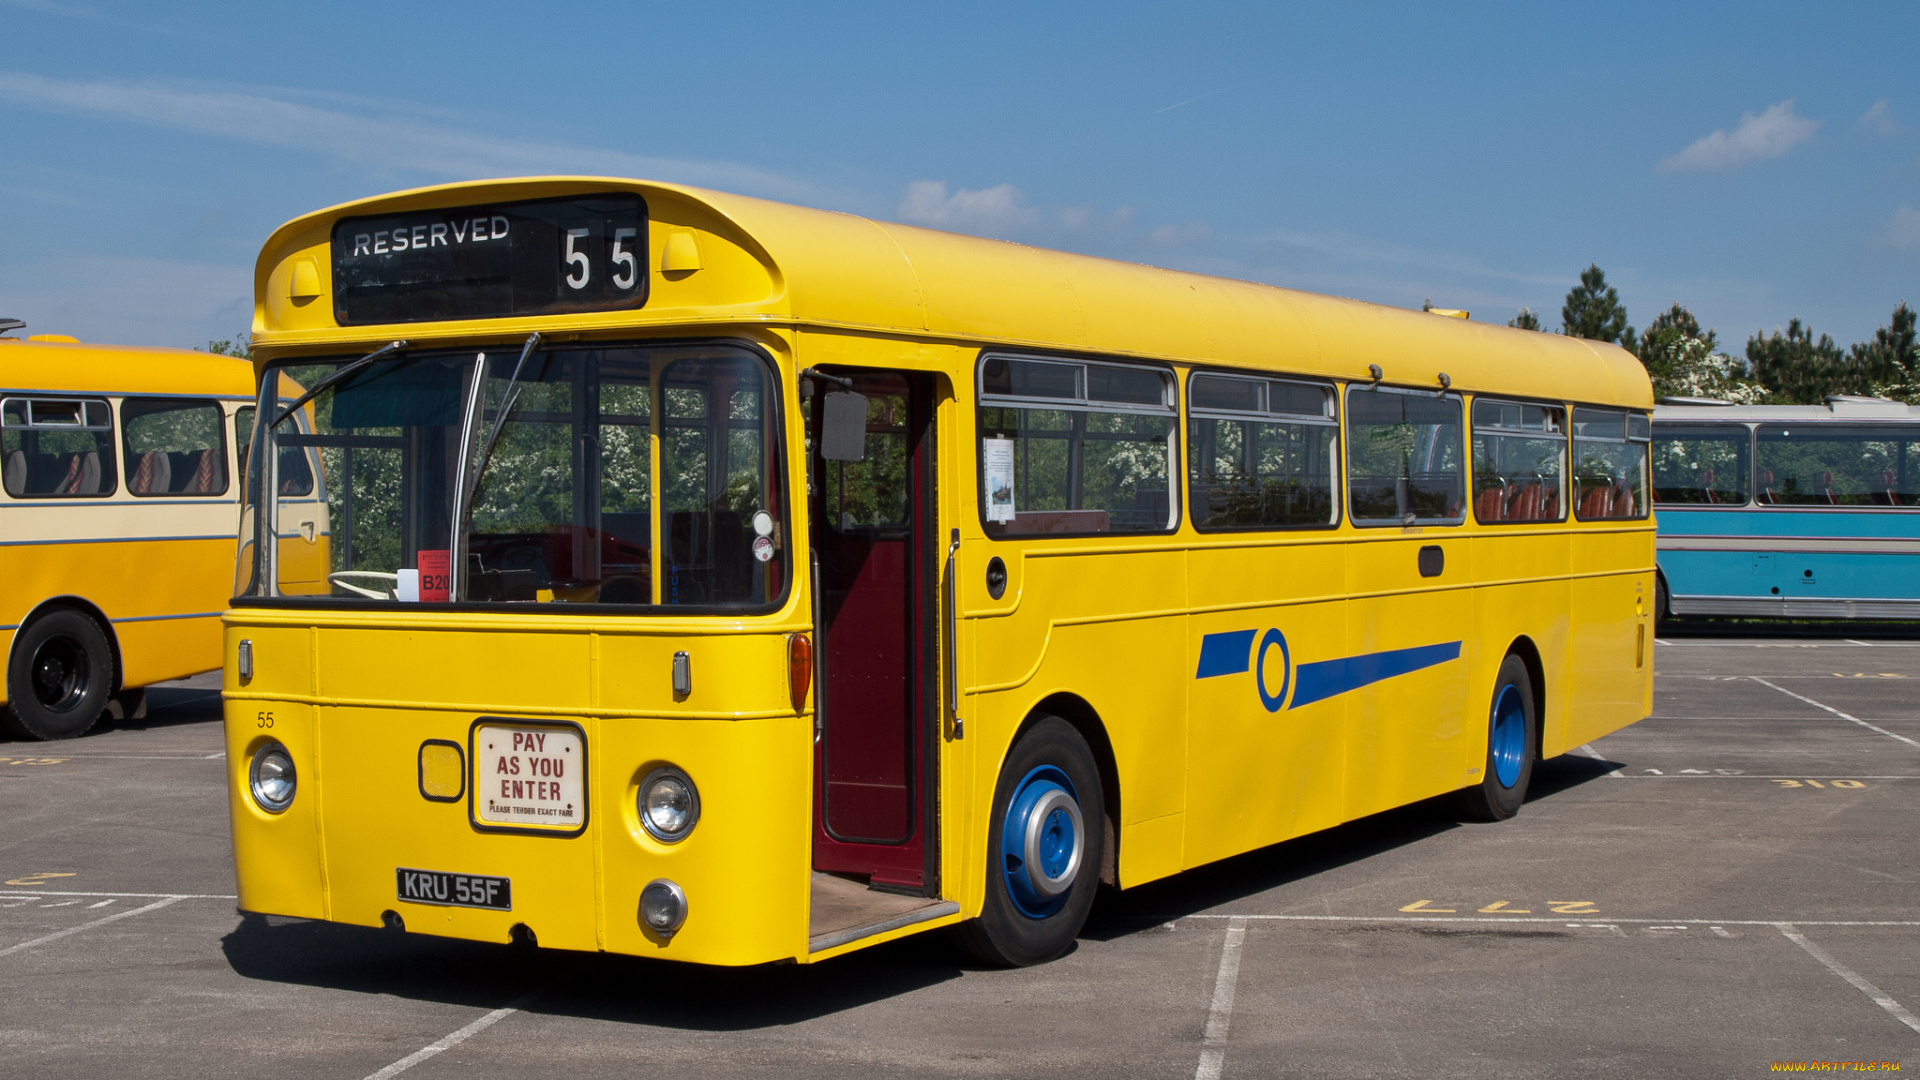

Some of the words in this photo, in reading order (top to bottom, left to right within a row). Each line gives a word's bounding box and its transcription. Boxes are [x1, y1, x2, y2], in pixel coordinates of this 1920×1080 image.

[353, 216, 510, 257] RESERVED
[257, 712, 275, 729] 55
[513, 732, 546, 753] PAY
[496, 756, 520, 776] AS
[529, 757, 564, 778] YOU
[501, 779, 561, 801] ENTER
[489, 805, 511, 814] PLEASE
[513, 806, 536, 815] TENDER
[538, 808, 557, 817] EXACT
[558, 809, 574, 818] FARE
[404, 872, 448, 901] KRU
[455, 876, 500, 905] 55F
